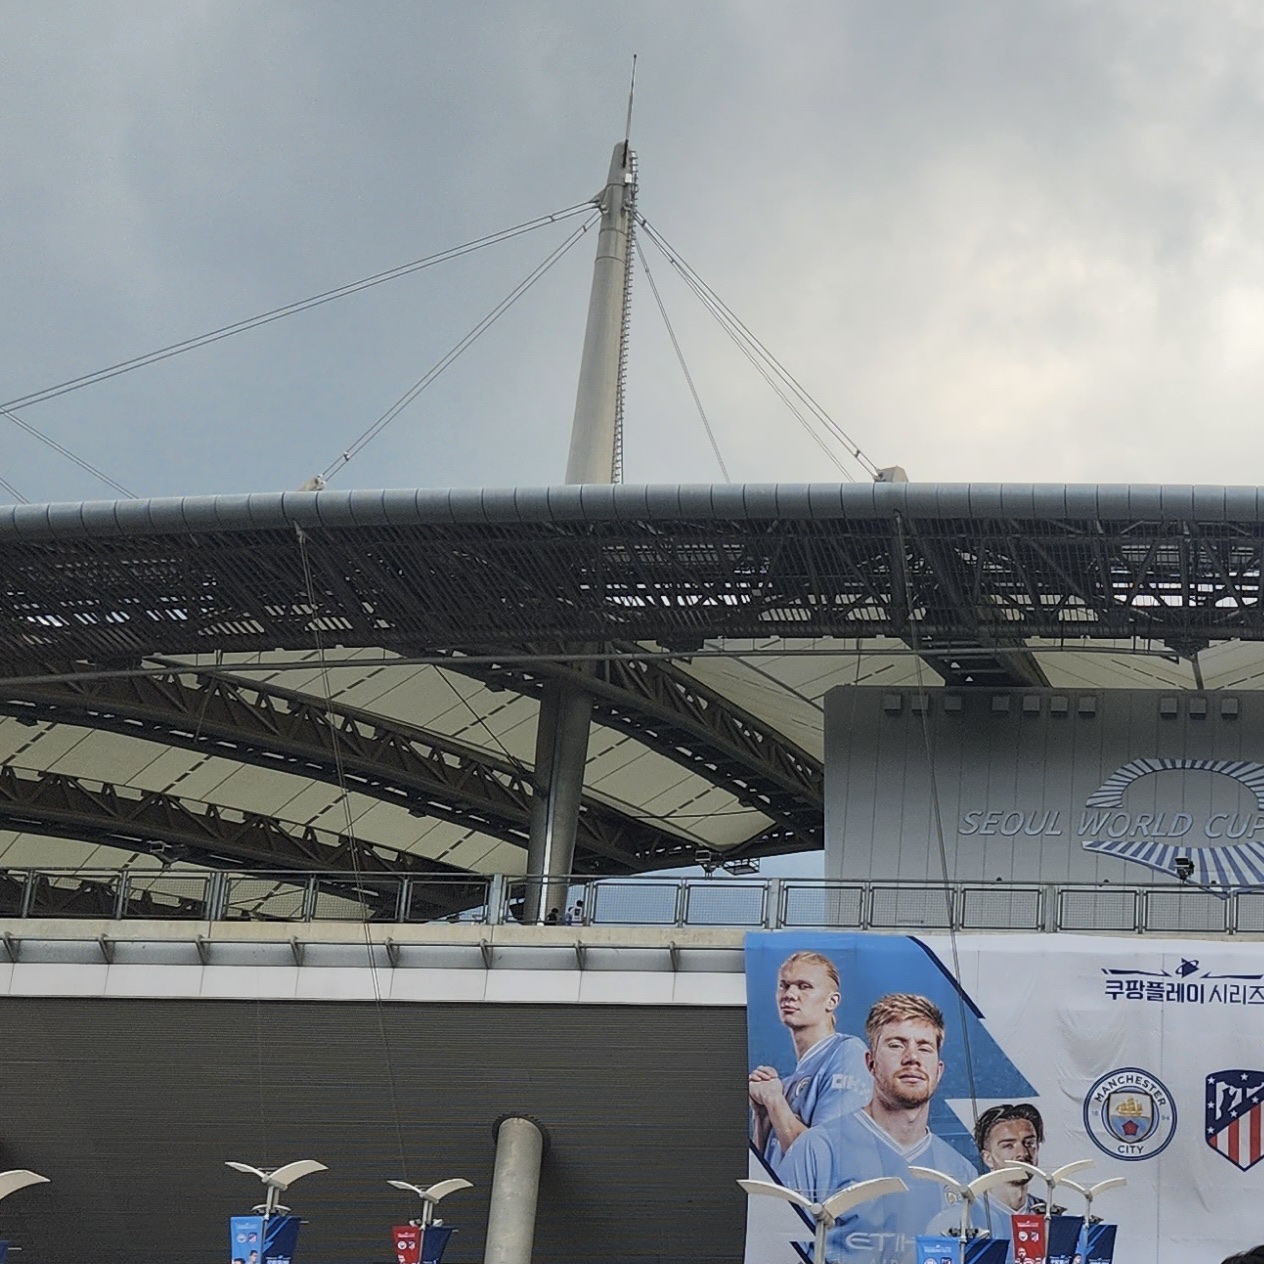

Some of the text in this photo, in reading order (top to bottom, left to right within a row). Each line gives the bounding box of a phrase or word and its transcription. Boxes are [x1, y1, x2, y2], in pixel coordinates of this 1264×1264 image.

[959, 809, 1063, 837] SEOUL
[1077, 811, 1193, 838] WORLD
[1105, 980, 1204, 1004] 쿠팡플레이
[1093, 1075, 1166, 1107] MANCHESTER
[1117, 1145, 1144, 1154] CITY
